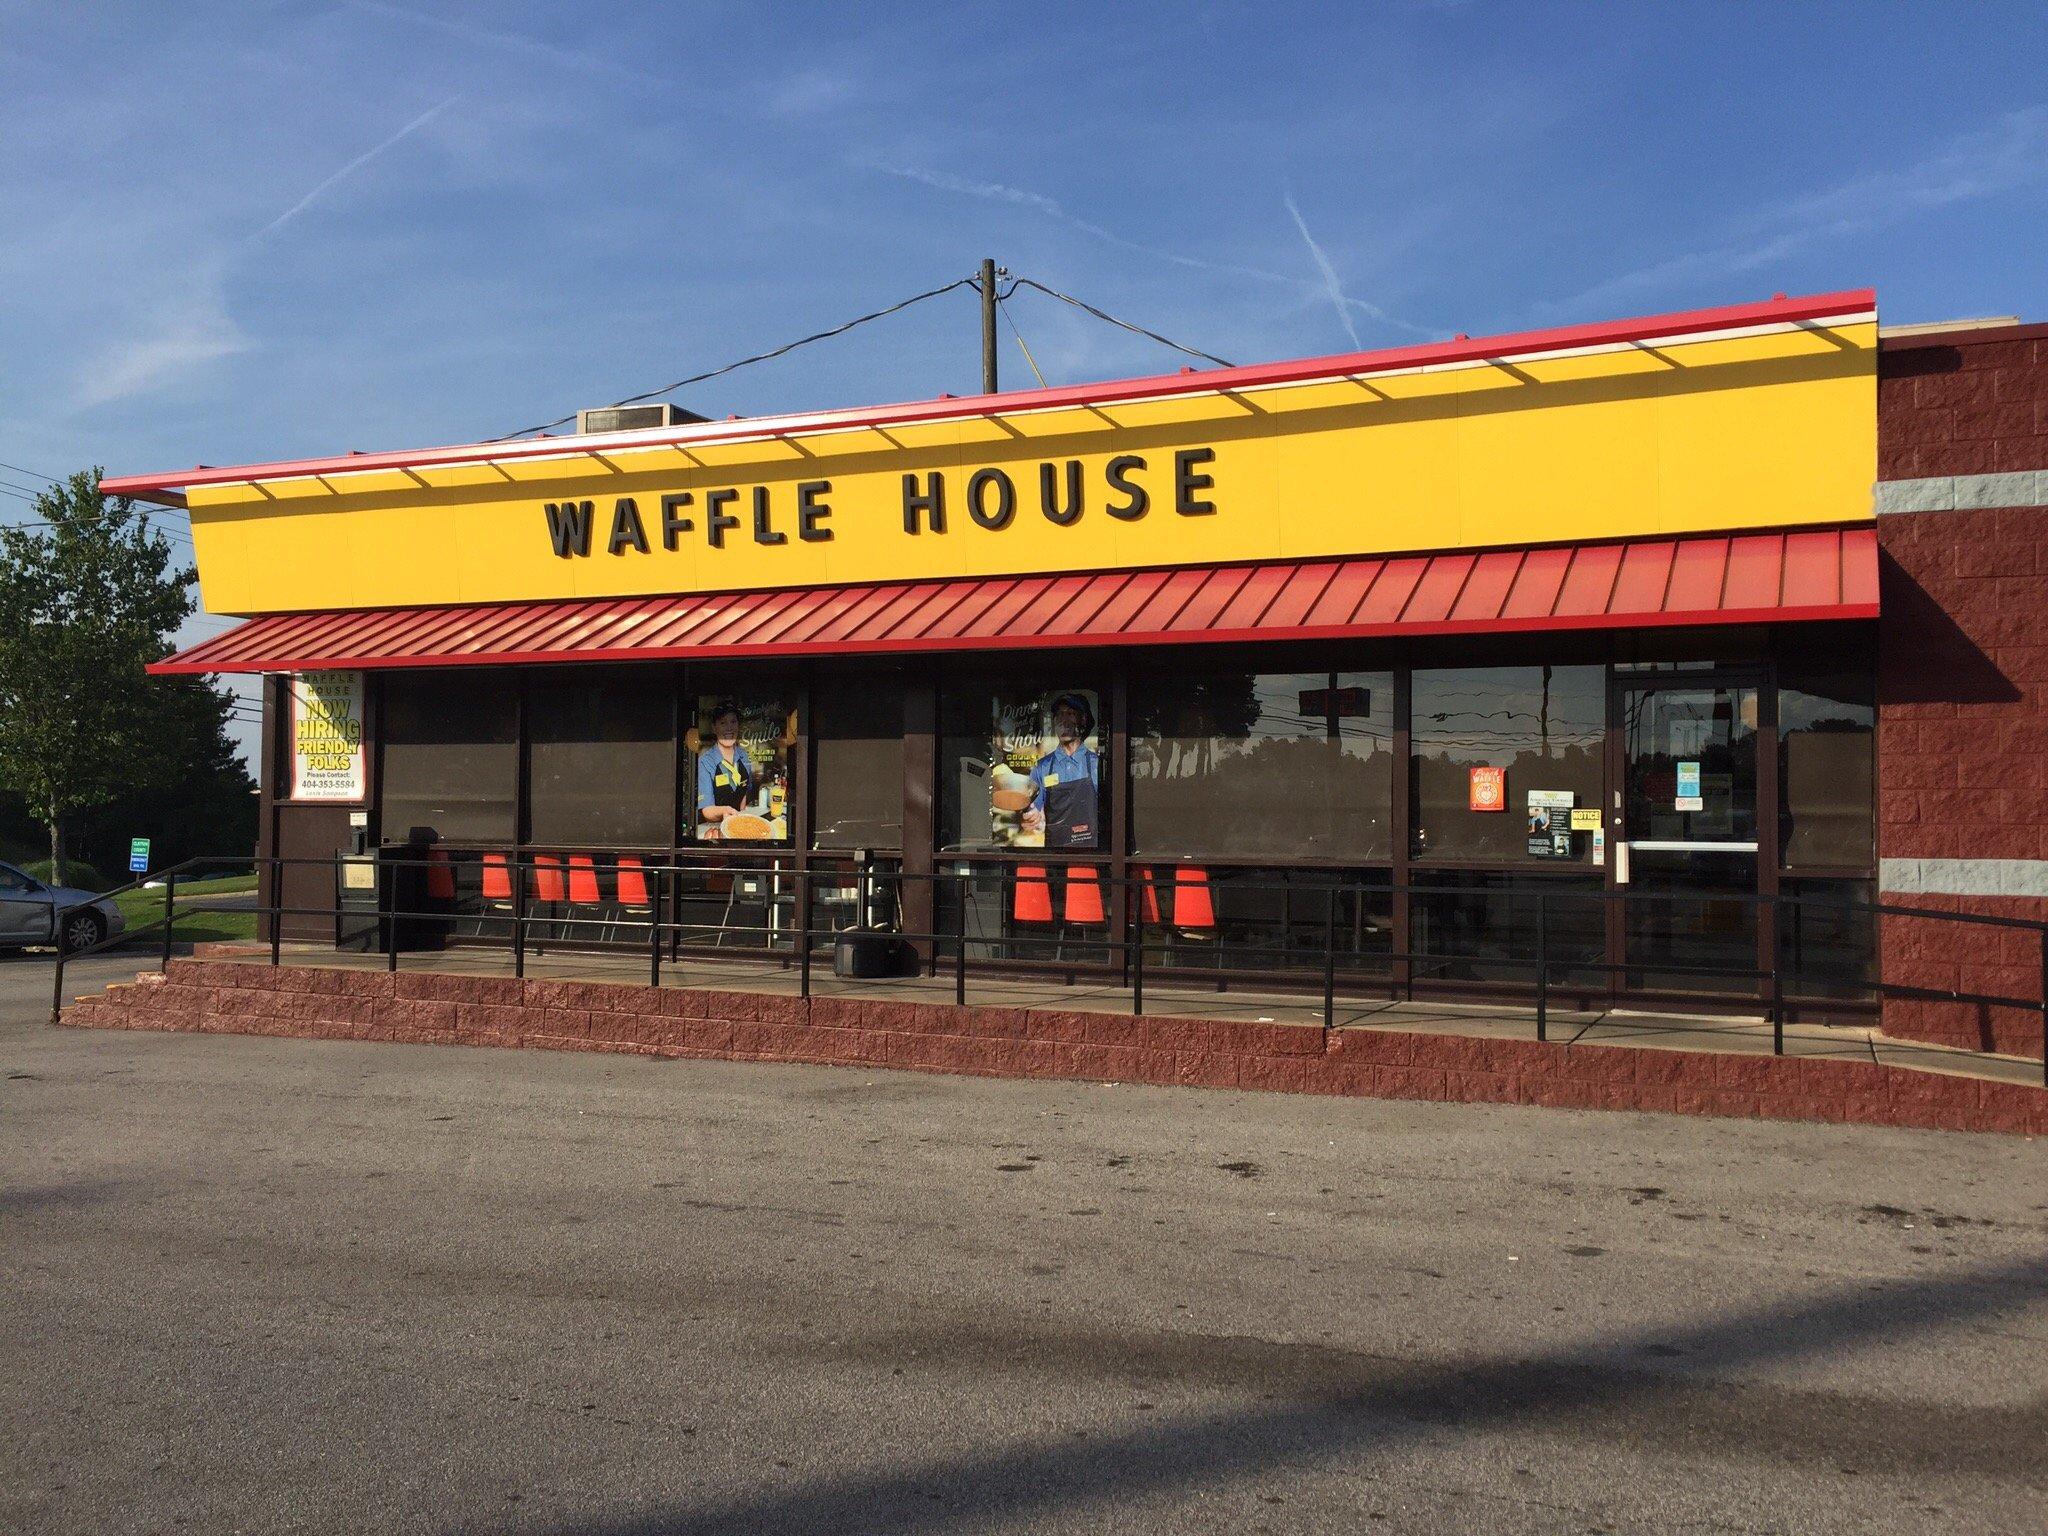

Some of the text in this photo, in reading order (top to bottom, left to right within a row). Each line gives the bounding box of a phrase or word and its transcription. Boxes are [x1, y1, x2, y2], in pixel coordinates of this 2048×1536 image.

[544, 447, 1217, 557] WAFFLE HOUSE
[303, 674, 355, 684] WAFFLE
[309, 686, 351, 696] HOUSE
[306, 699, 351, 720] NOW
[297, 719, 360, 740] HIRING
[740, 721, 781, 747] Smile
[297, 740, 360, 755] FRIENDLY
[307, 755, 351, 770] FOLKS
[302, 780, 355, 788] 404-353-5584
[1573, 810, 1600, 820] NOTICE
